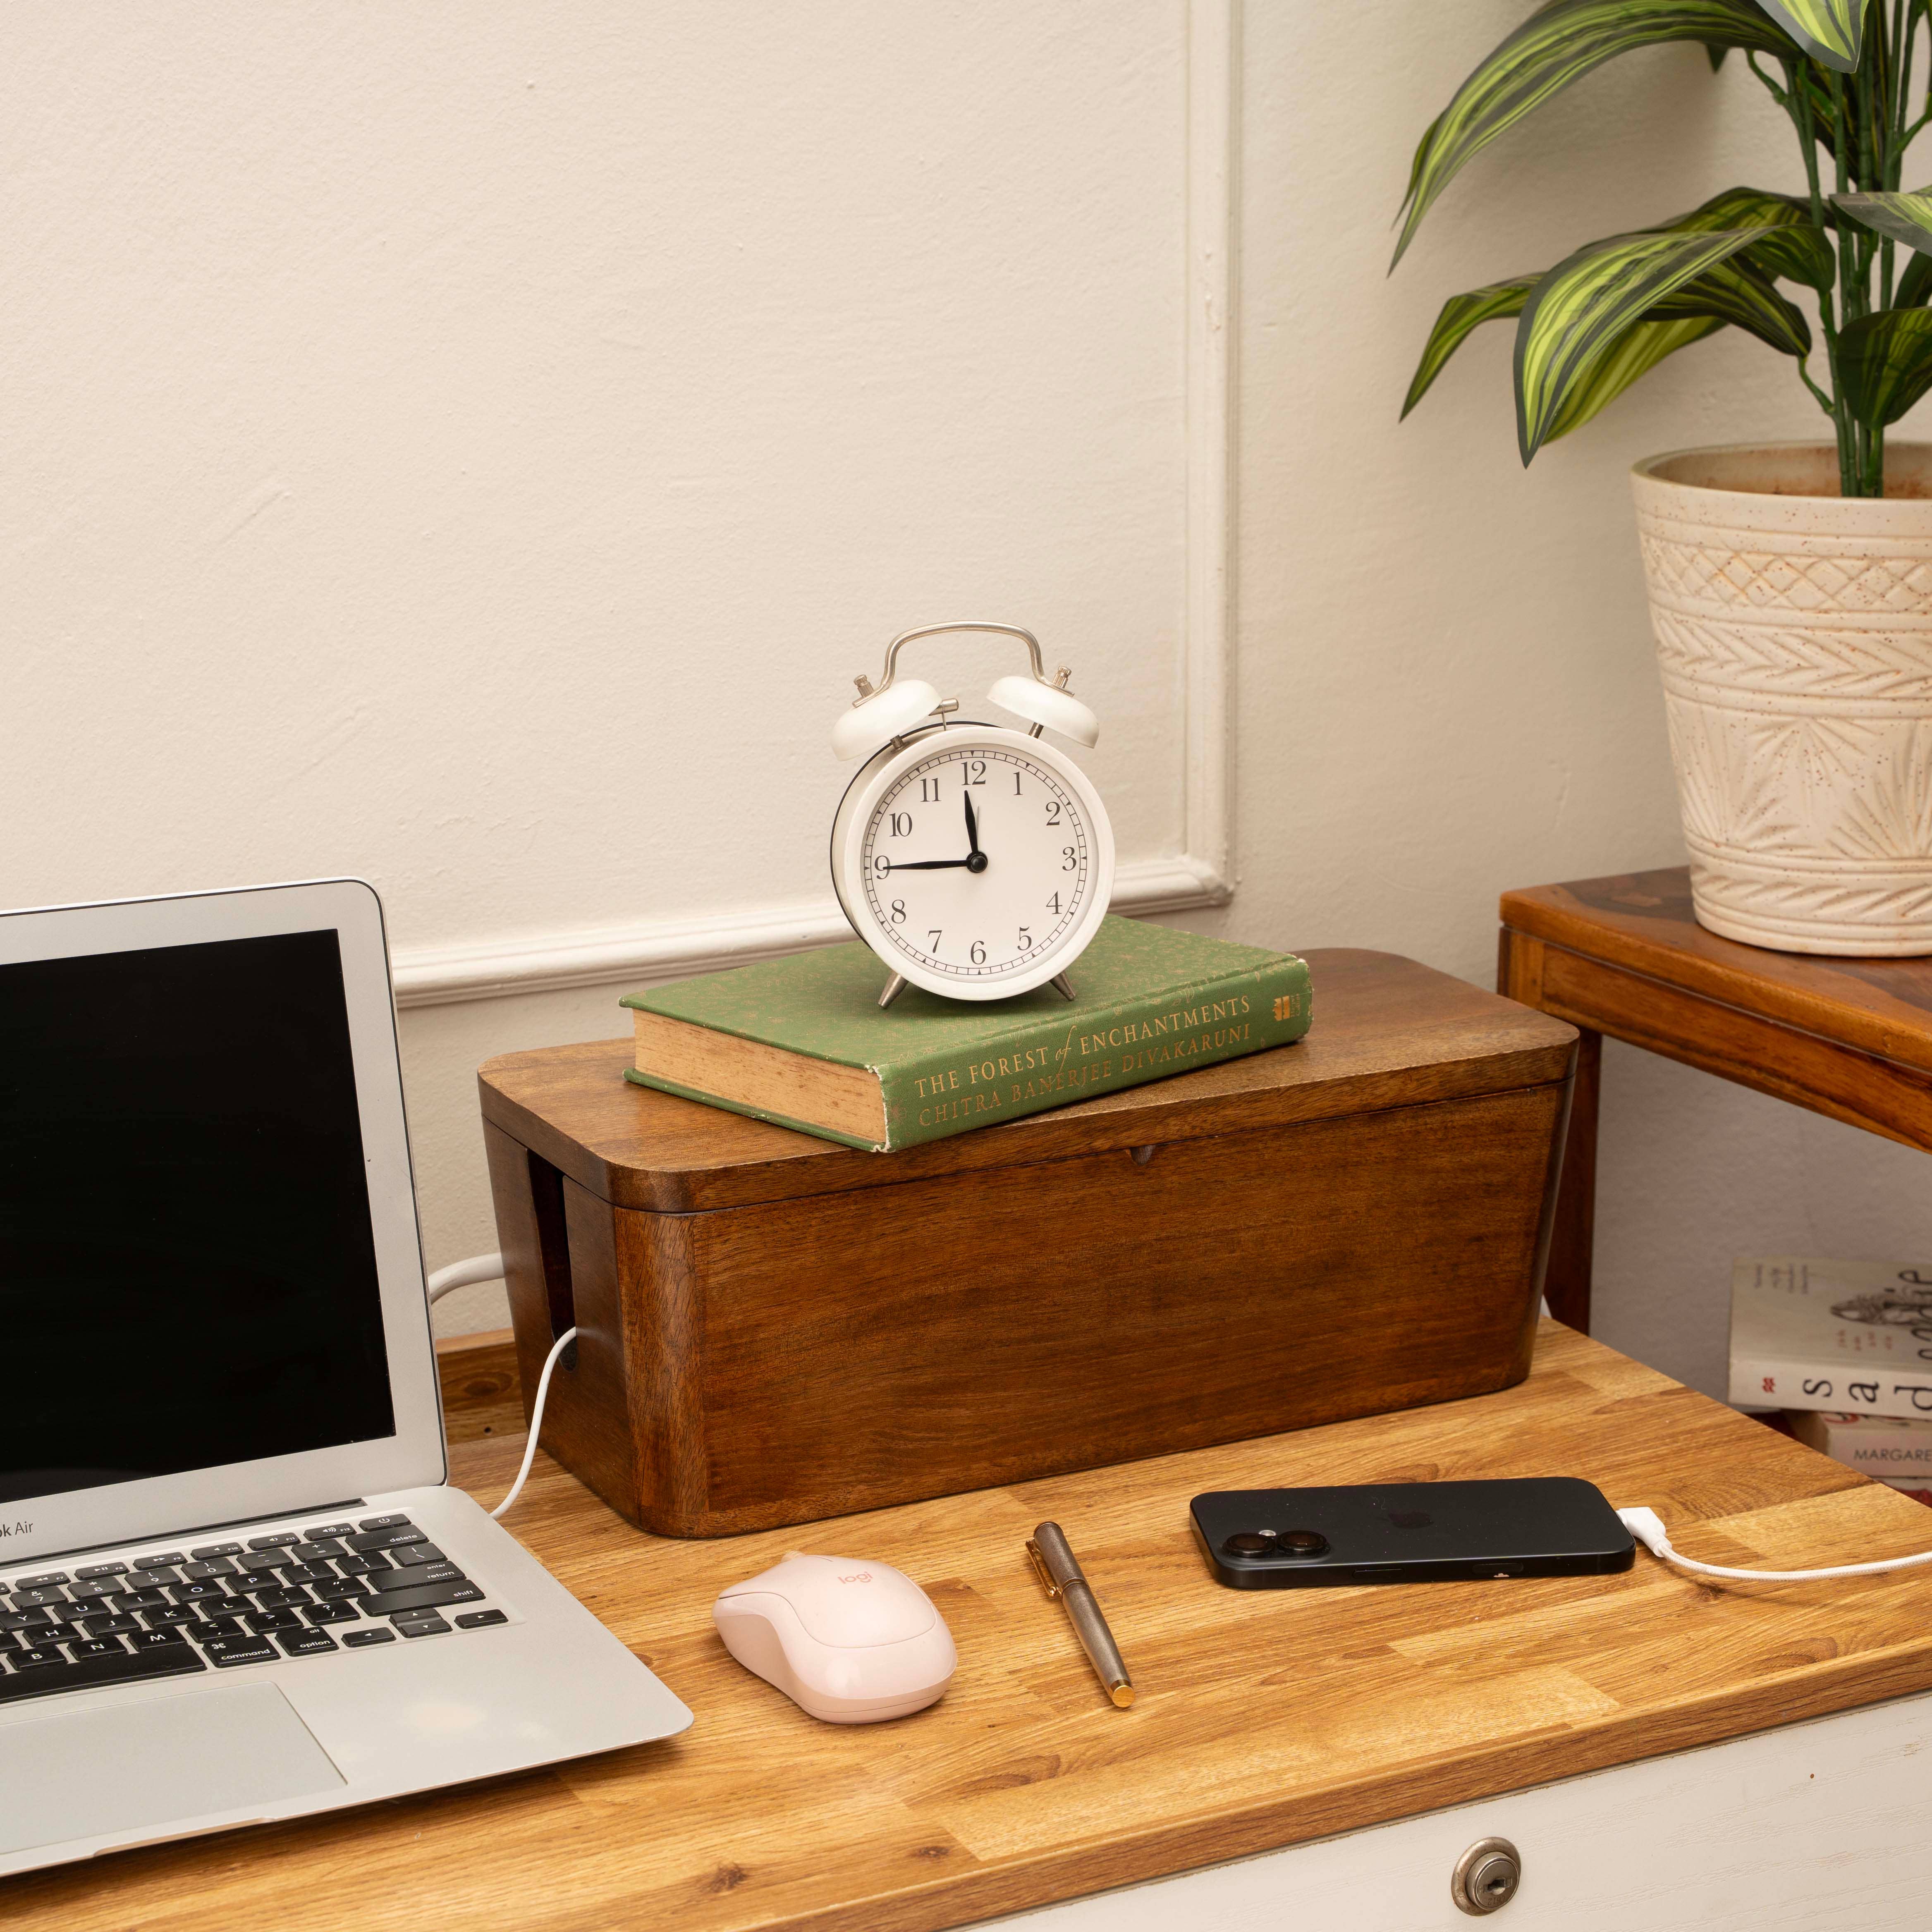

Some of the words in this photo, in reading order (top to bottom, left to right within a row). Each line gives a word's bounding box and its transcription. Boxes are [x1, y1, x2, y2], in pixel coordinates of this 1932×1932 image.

[961, 761, 986, 785] 12
[1014, 772, 1023, 795] 1
[920, 778, 941, 802] 11
[1046, 801, 1060, 825] 2
[889, 813, 912, 837] 10
[875, 856, 890, 879] 9
[1062, 847, 1076, 870] 3
[891, 899, 906, 923] 8
[1046, 890, 1062, 914] 4
[928, 930, 942, 953] 7
[1018, 926, 1032, 951] 5
[971, 941, 986, 964] 6
[914, 1071, 959, 1098] THE
[969, 1047, 1048, 1084] FOREST
[1053, 1025, 1077, 1081] of
[1079, 995, 1250, 1054] ENCHANTMENTS
[919, 1091, 1001, 1126] CHITRA
[1011, 1059, 1112, 1102] BANERJEE
[1122, 1023, 1250, 1072] DIVAKARUNI
[1854, 1448, 1932, 1462] MARGARE
[15, 1521, 33, 1535] Air
[837, 1571, 873, 1584] logi
[222, 1649, 271, 1659] command
